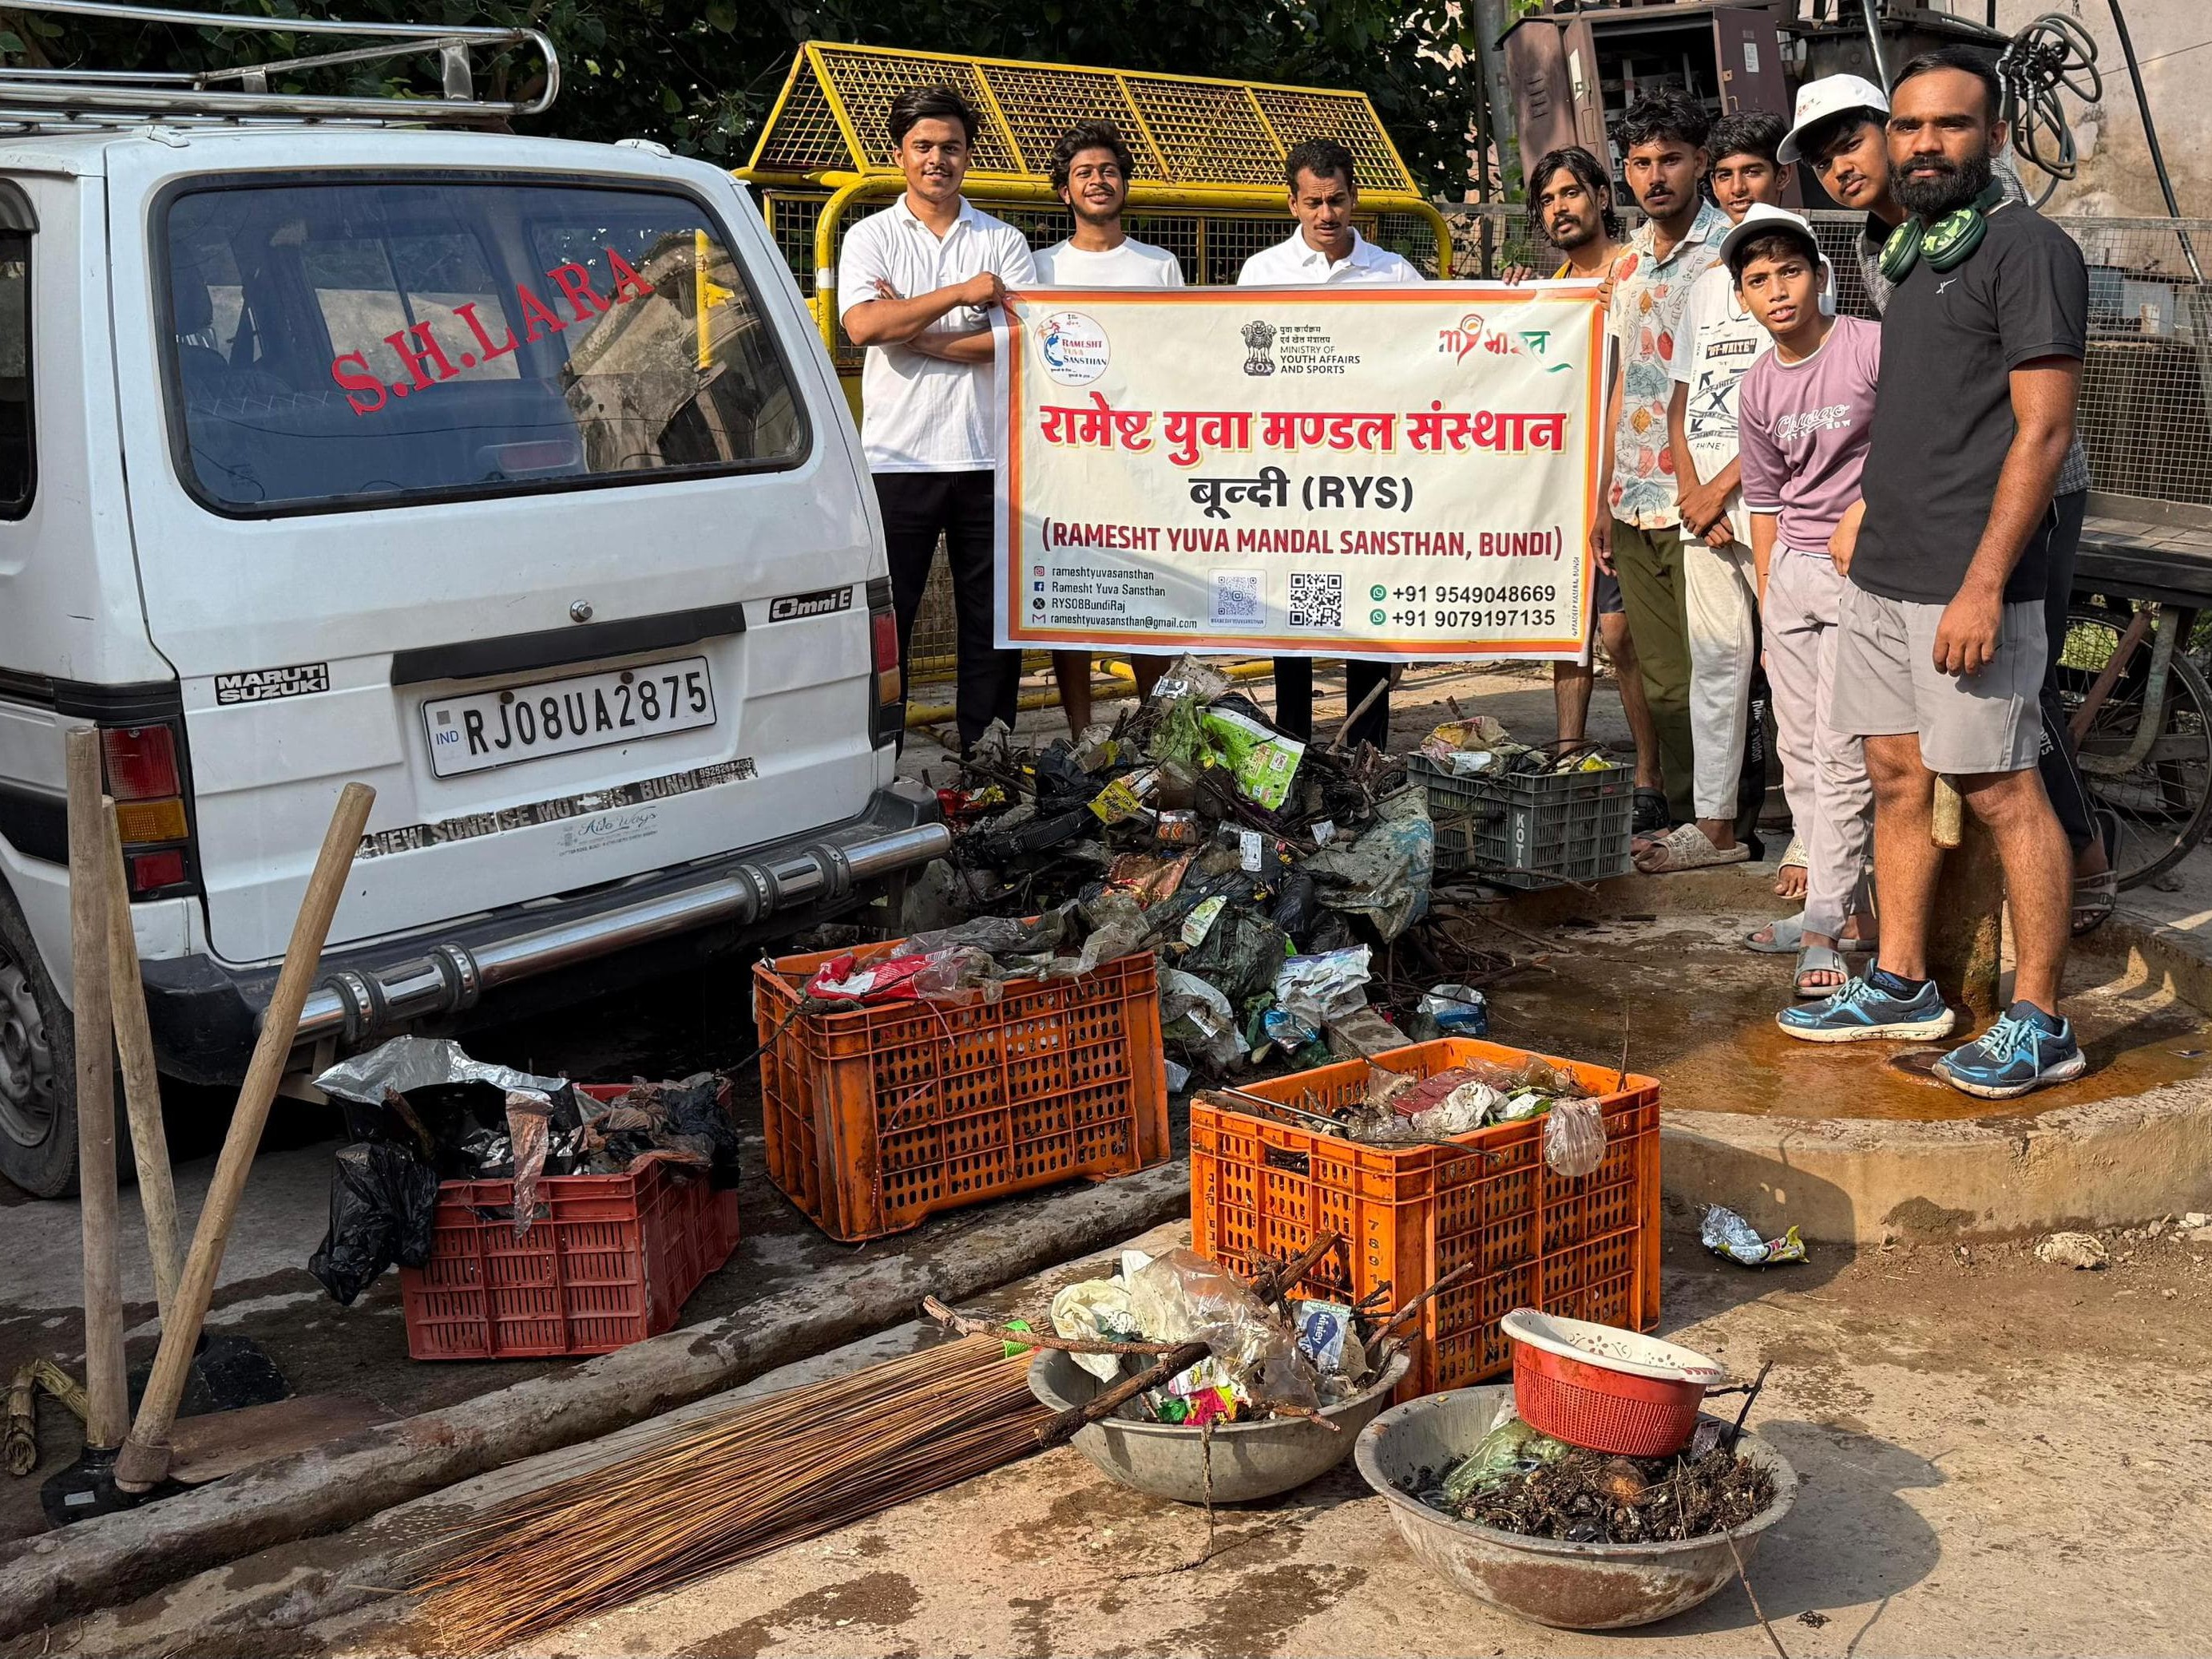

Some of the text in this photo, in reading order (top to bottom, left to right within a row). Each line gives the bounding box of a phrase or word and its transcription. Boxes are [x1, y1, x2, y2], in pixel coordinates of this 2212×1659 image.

[331, 247, 655, 416] S.H.LARA
[1062, 339, 1102, 349] RAMESHT
[1063, 355, 1107, 366] SANSTHAN
[1280, 355, 1361, 364] YOUTH AFFAIRS
[1280, 365, 1345, 374] AND SPORTS
[1040, 391, 1567, 466] रामेष्ट युवा मण्डल संस्थान
[1188, 466, 1413, 519] बून्दी (RYS)
[1042, 517, 1563, 561] (RAMESHT YUVA MANDAL SANSTHAN, BUNDI)
[1052, 566, 1154, 580] rameshtyuvasansthan
[1052, 581, 1166, 597] Ramesht Yuva Sansthan
[1393, 585, 1556, 604] +91 9549048669
[772, 588, 851, 620] Omni E
[1052, 598, 1126, 613] RYS08BundiRaj
[1051, 614, 1197, 629] rameshtyuvasansthan@gmail.com
[1392, 609, 1556, 628] +91 9079197135
[218, 664, 325, 690] MARUTI
[219, 678, 327, 703] SUZUKI
[462, 671, 708, 755] RJ08UA2875
[436, 730, 459, 746] IND
[376, 825, 424, 856] NEW
[640, 769, 700, 801] BUNDI
